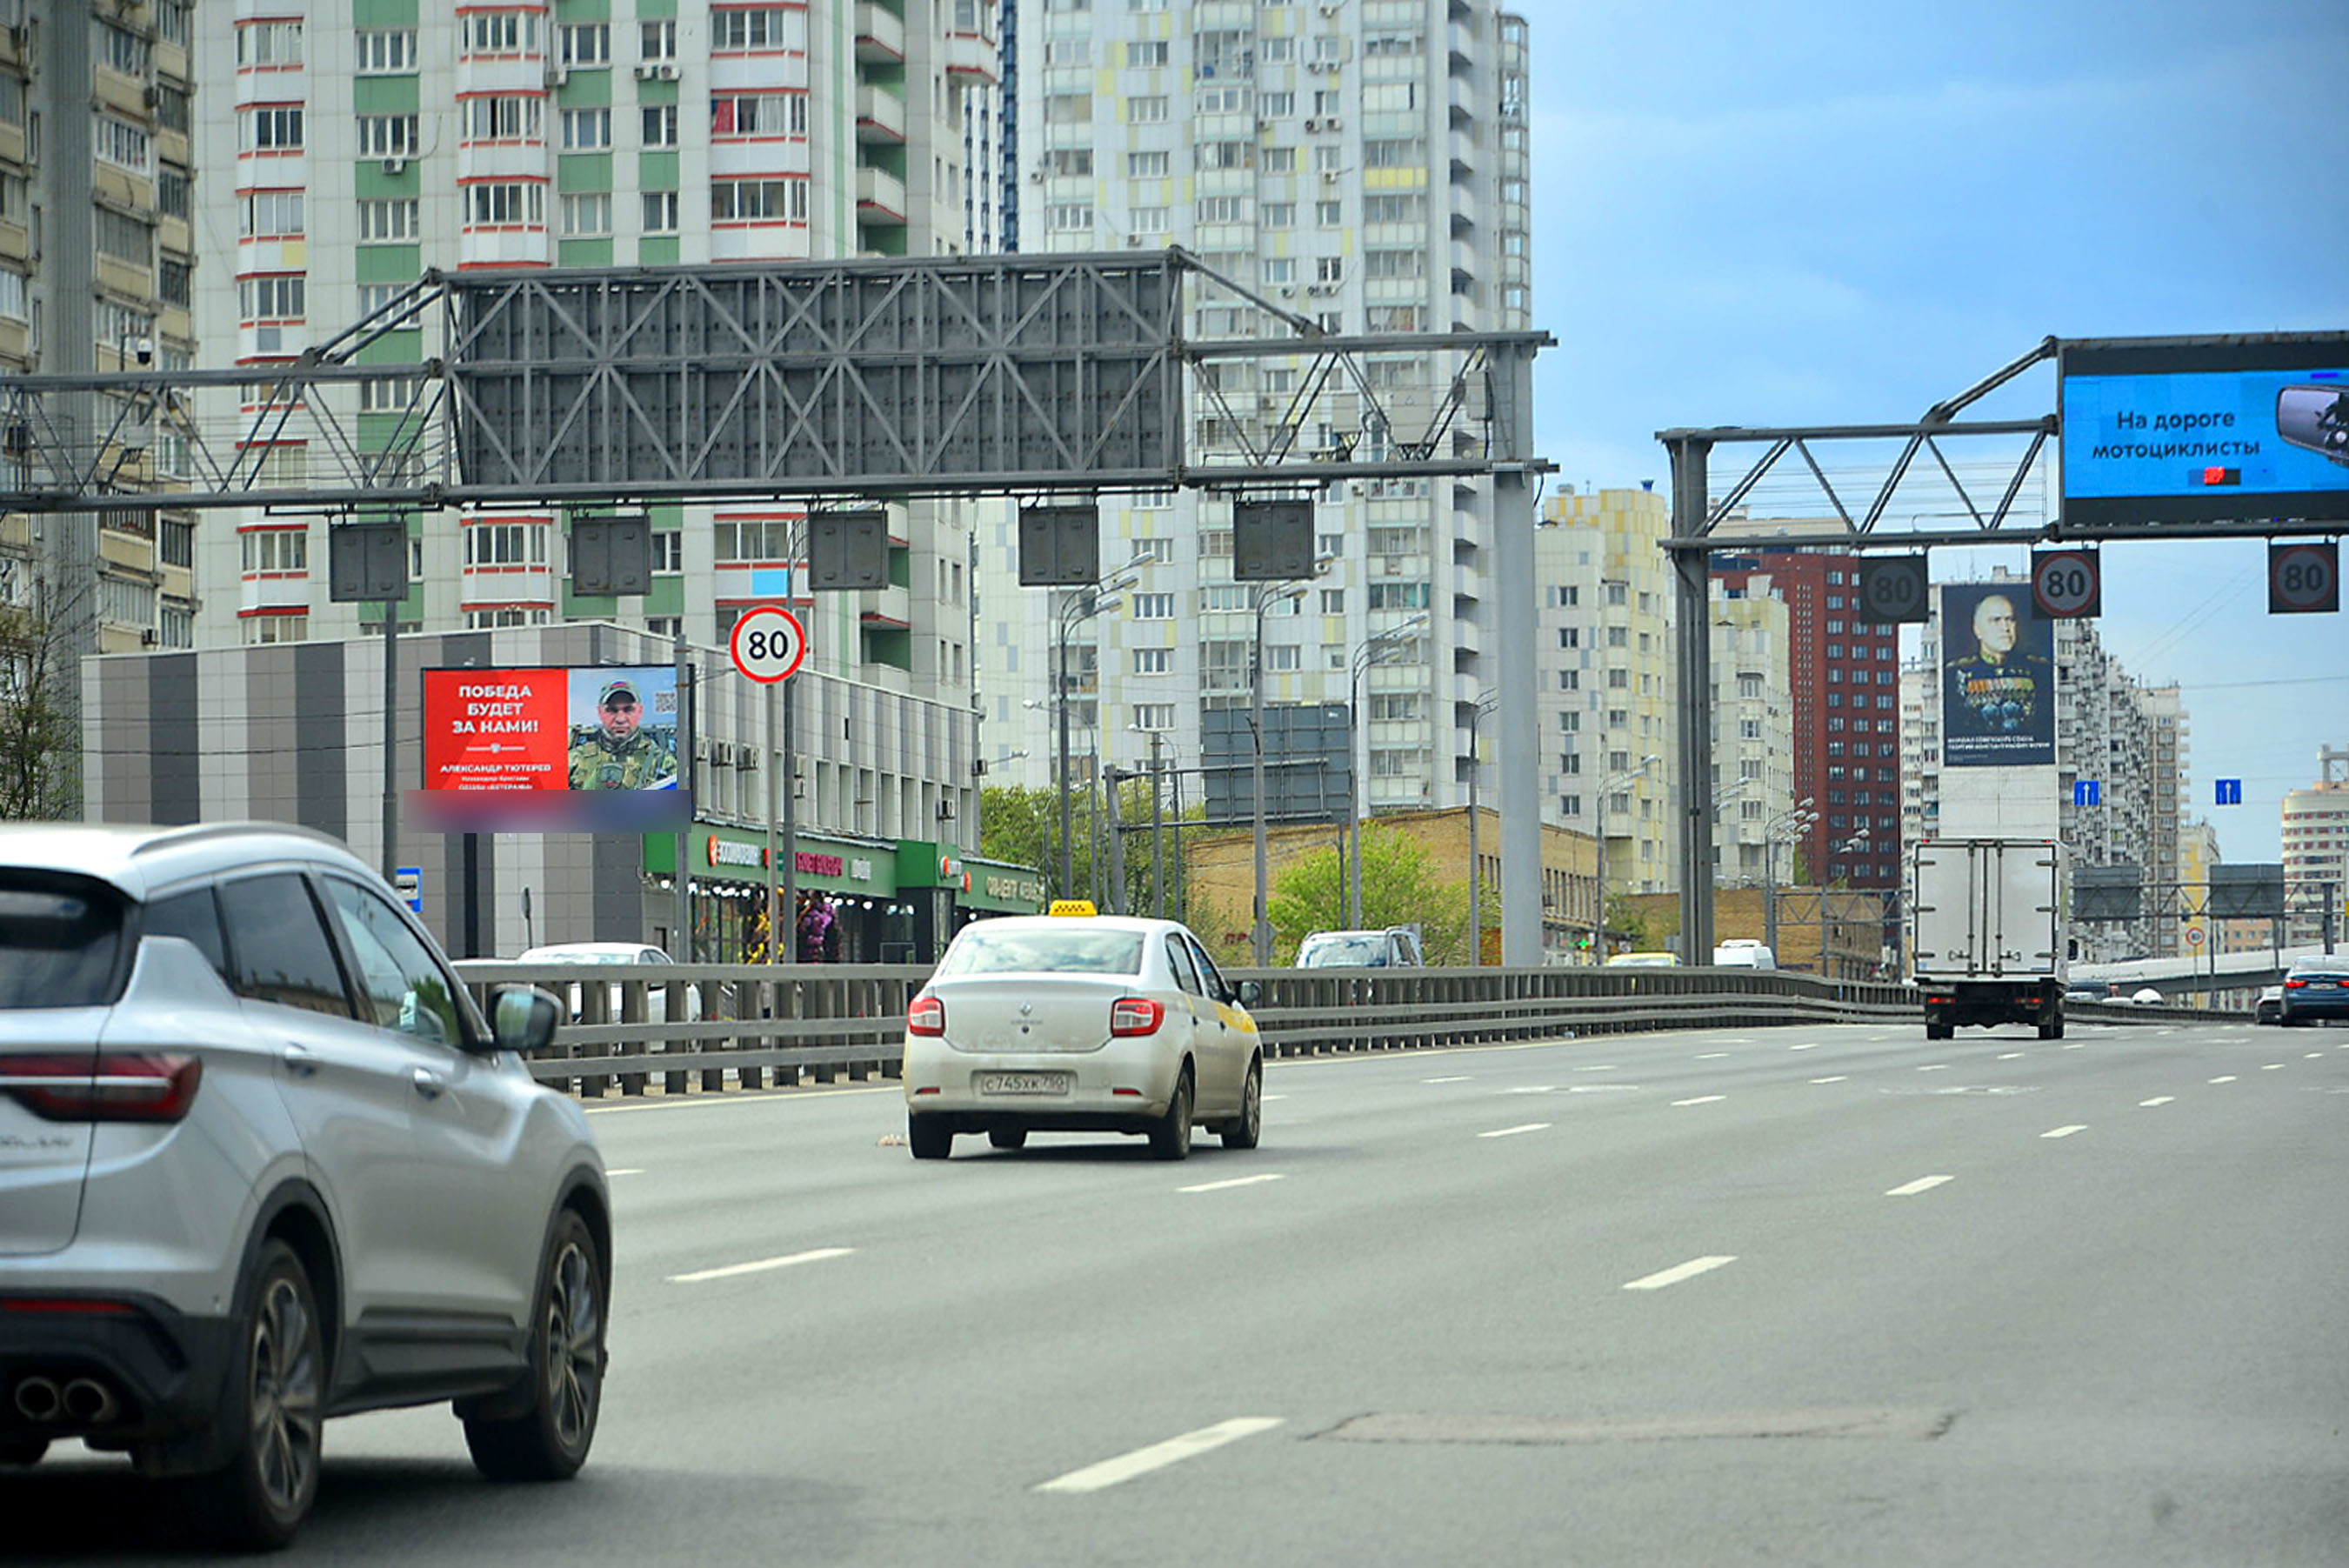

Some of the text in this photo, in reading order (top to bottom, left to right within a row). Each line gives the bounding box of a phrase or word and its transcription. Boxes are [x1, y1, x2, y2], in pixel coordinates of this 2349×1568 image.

[2117, 411, 2236, 432] На дороге
[2092, 440, 2260, 460] мотоциклисты
[2046, 569, 2085, 598] 80
[2284, 563, 2324, 592] 80
[1875, 576, 1913, 604] 80
[748, 631, 789, 660] 80
[458, 684, 532, 698] ПОБЕДА
[467, 702, 524, 717] БУДЕТ
[451, 718, 539, 734] ЗА НАМИ!
[440, 764, 503, 773] АЛЕКСАНДР
